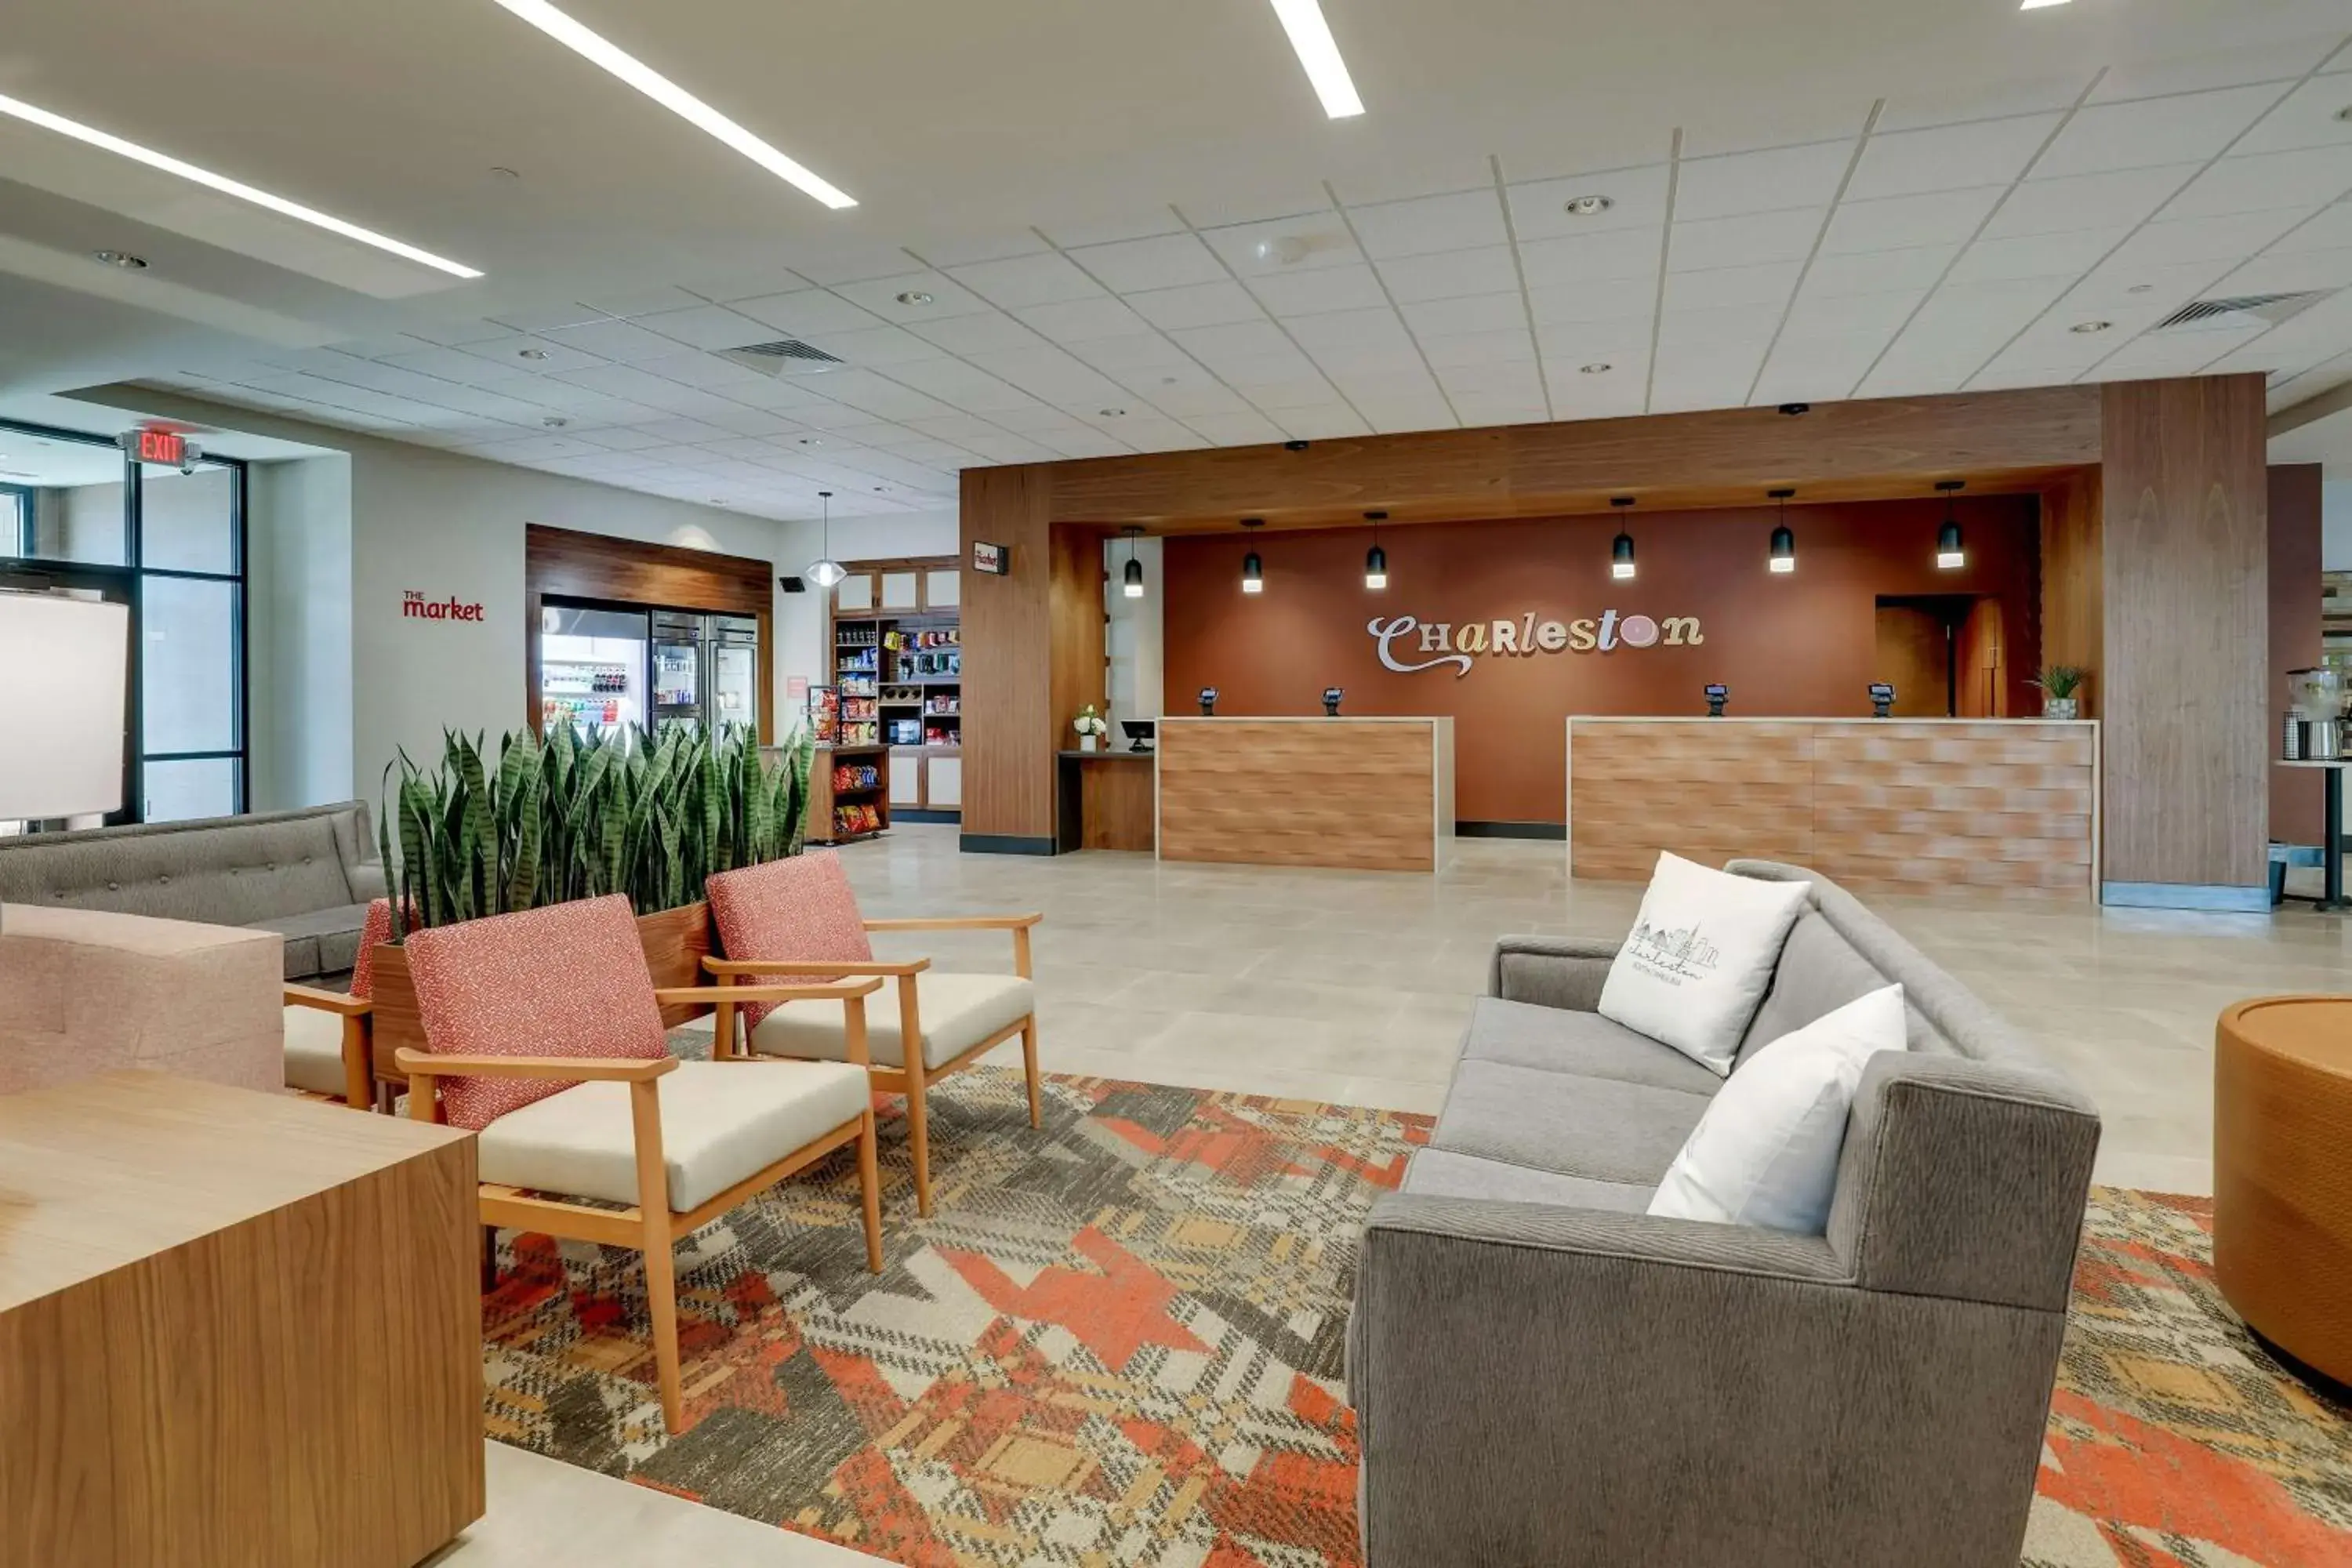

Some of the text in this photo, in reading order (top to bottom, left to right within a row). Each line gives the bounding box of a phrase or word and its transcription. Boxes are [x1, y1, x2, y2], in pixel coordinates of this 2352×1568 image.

[141, 433, 179, 461] EXIT
[404, 590, 424, 601] THE
[403, 596, 484, 621] market
